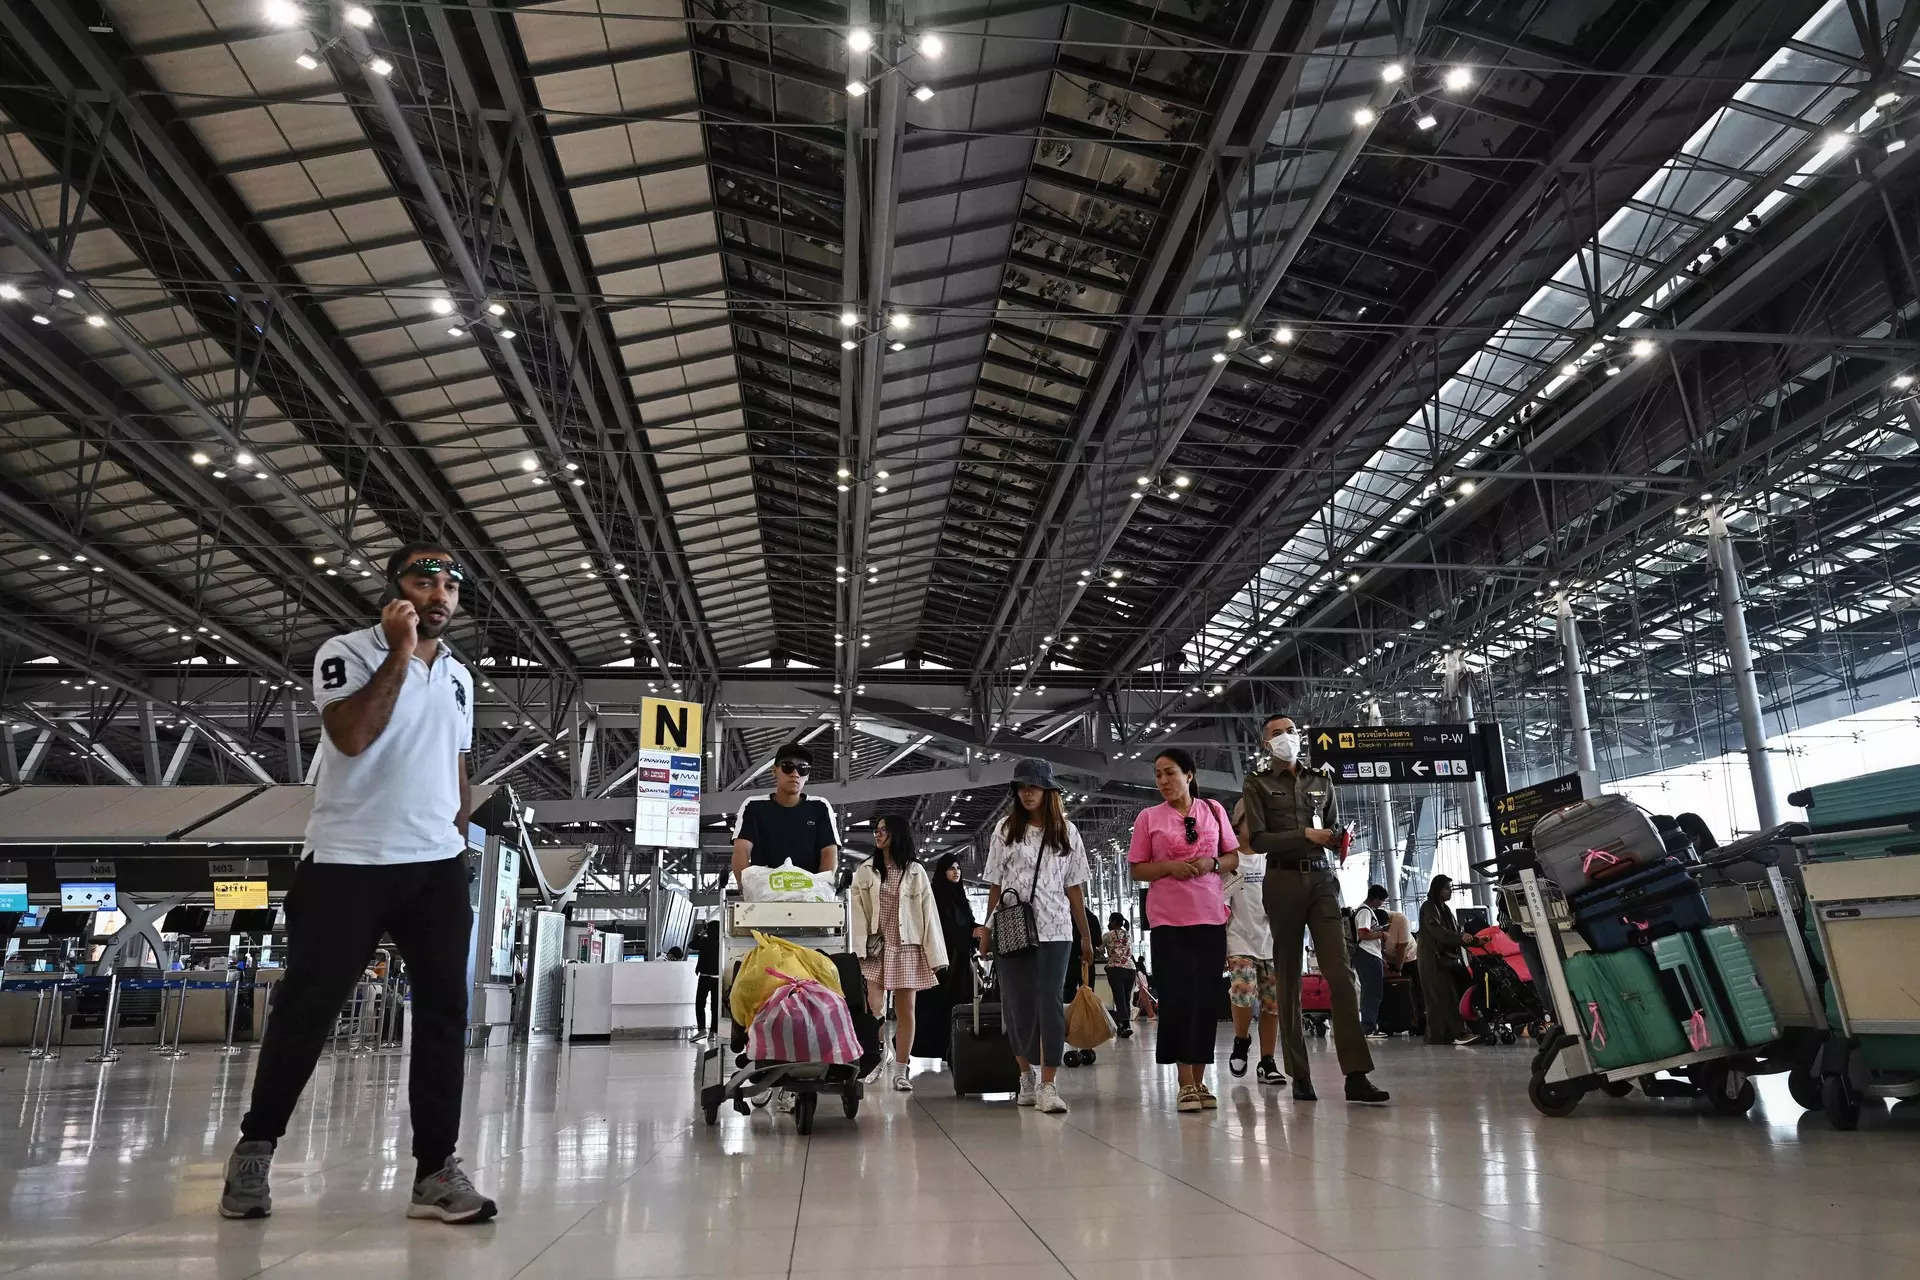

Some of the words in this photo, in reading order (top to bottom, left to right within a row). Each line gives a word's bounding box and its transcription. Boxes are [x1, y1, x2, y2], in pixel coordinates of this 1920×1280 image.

[320, 656, 347, 690] 9
[655, 704, 688, 748] N
[1440, 733, 1463, 744] P-W
